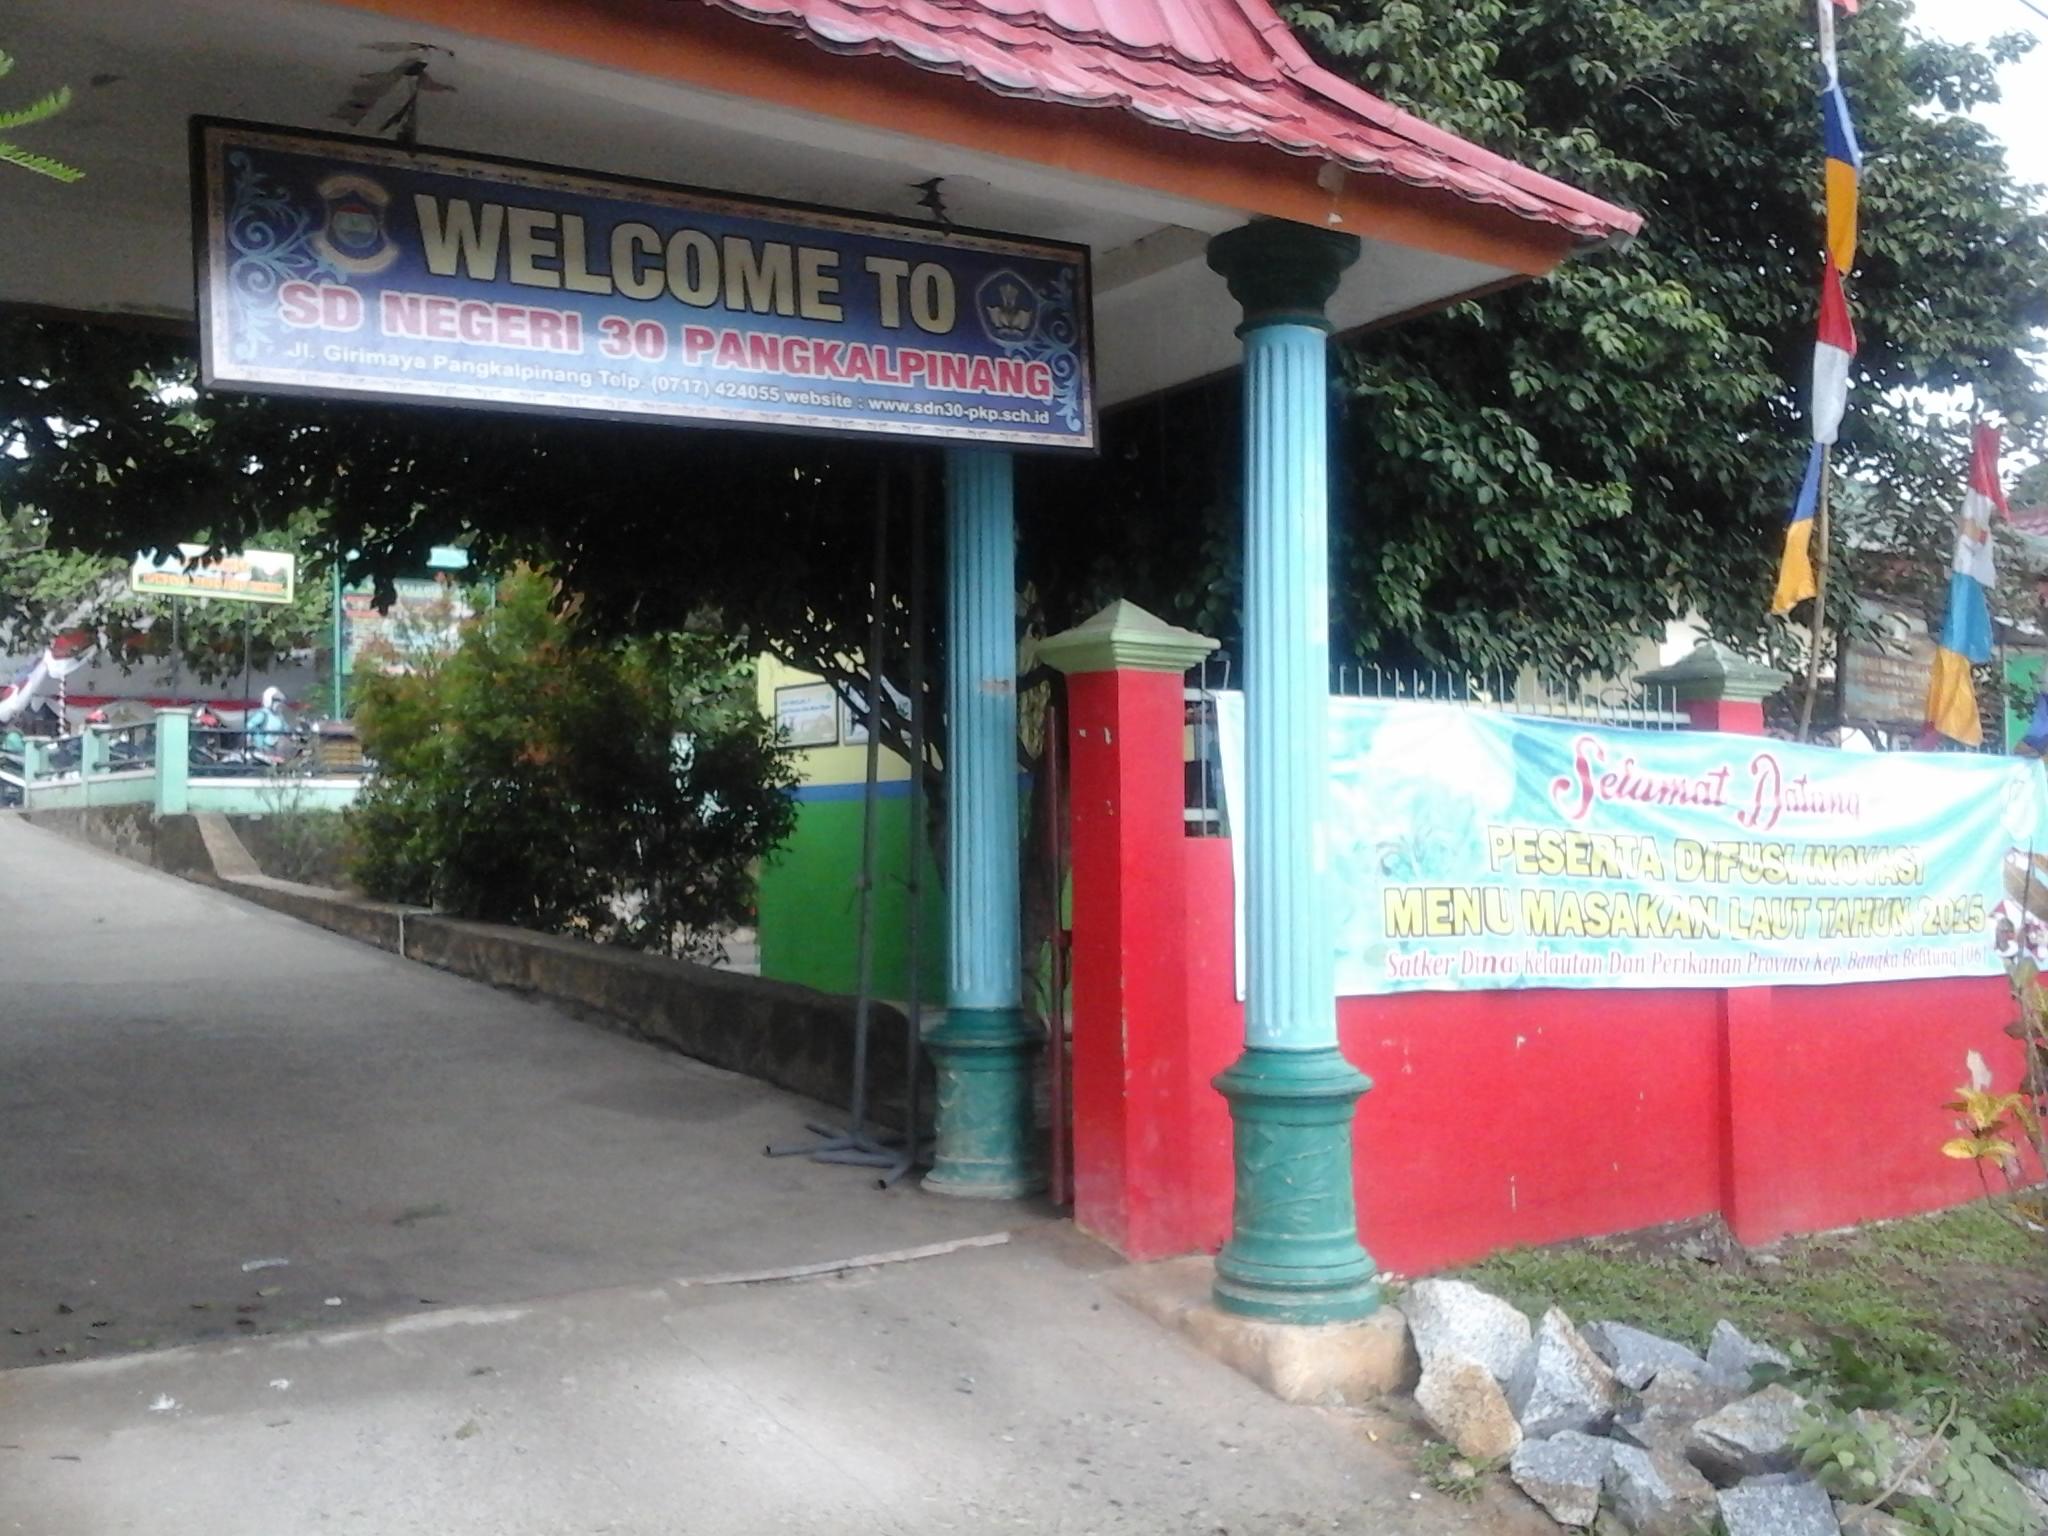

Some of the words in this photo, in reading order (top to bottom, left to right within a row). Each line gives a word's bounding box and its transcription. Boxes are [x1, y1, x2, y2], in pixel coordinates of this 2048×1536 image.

[414, 193, 844, 323] WELCOME
[865, 255, 956, 335] TO
[277, 282, 364, 330] SD
[380, 289, 584, 356] NEGERI
[598, 316, 667, 363] 30
[682, 324, 1055, 402] PANGKALPINANG
[323, 345, 427, 372] Girimaya
[434, 356, 593, 388] Pangkalpinang
[651, 376, 710, 398] (0717)
[715, 384, 780, 403] 424055
[784, 390, 853, 409] website
[867, 397, 1050, 426] www.sdn30-pkp.sch.id
[1552, 737, 1730, 820] Selamat
[1487, 825, 1665, 881] PESERTA
[1674, 838, 1799, 885] DIFUSI
[1384, 886, 1514, 938] MENU
[1520, 888, 1721, 939] MASAKAN
[1728, 895, 1812, 941] LAUT
[1816, 896, 1915, 939] TAHUN
[1918, 893, 1987, 936] 2015
[1387, 950, 1454, 977] Satker
[1461, 950, 1520, 975] Dinas
[1651, 951, 1742, 976] Perikanan
[1747, 950, 1811, 974] Provinsi
